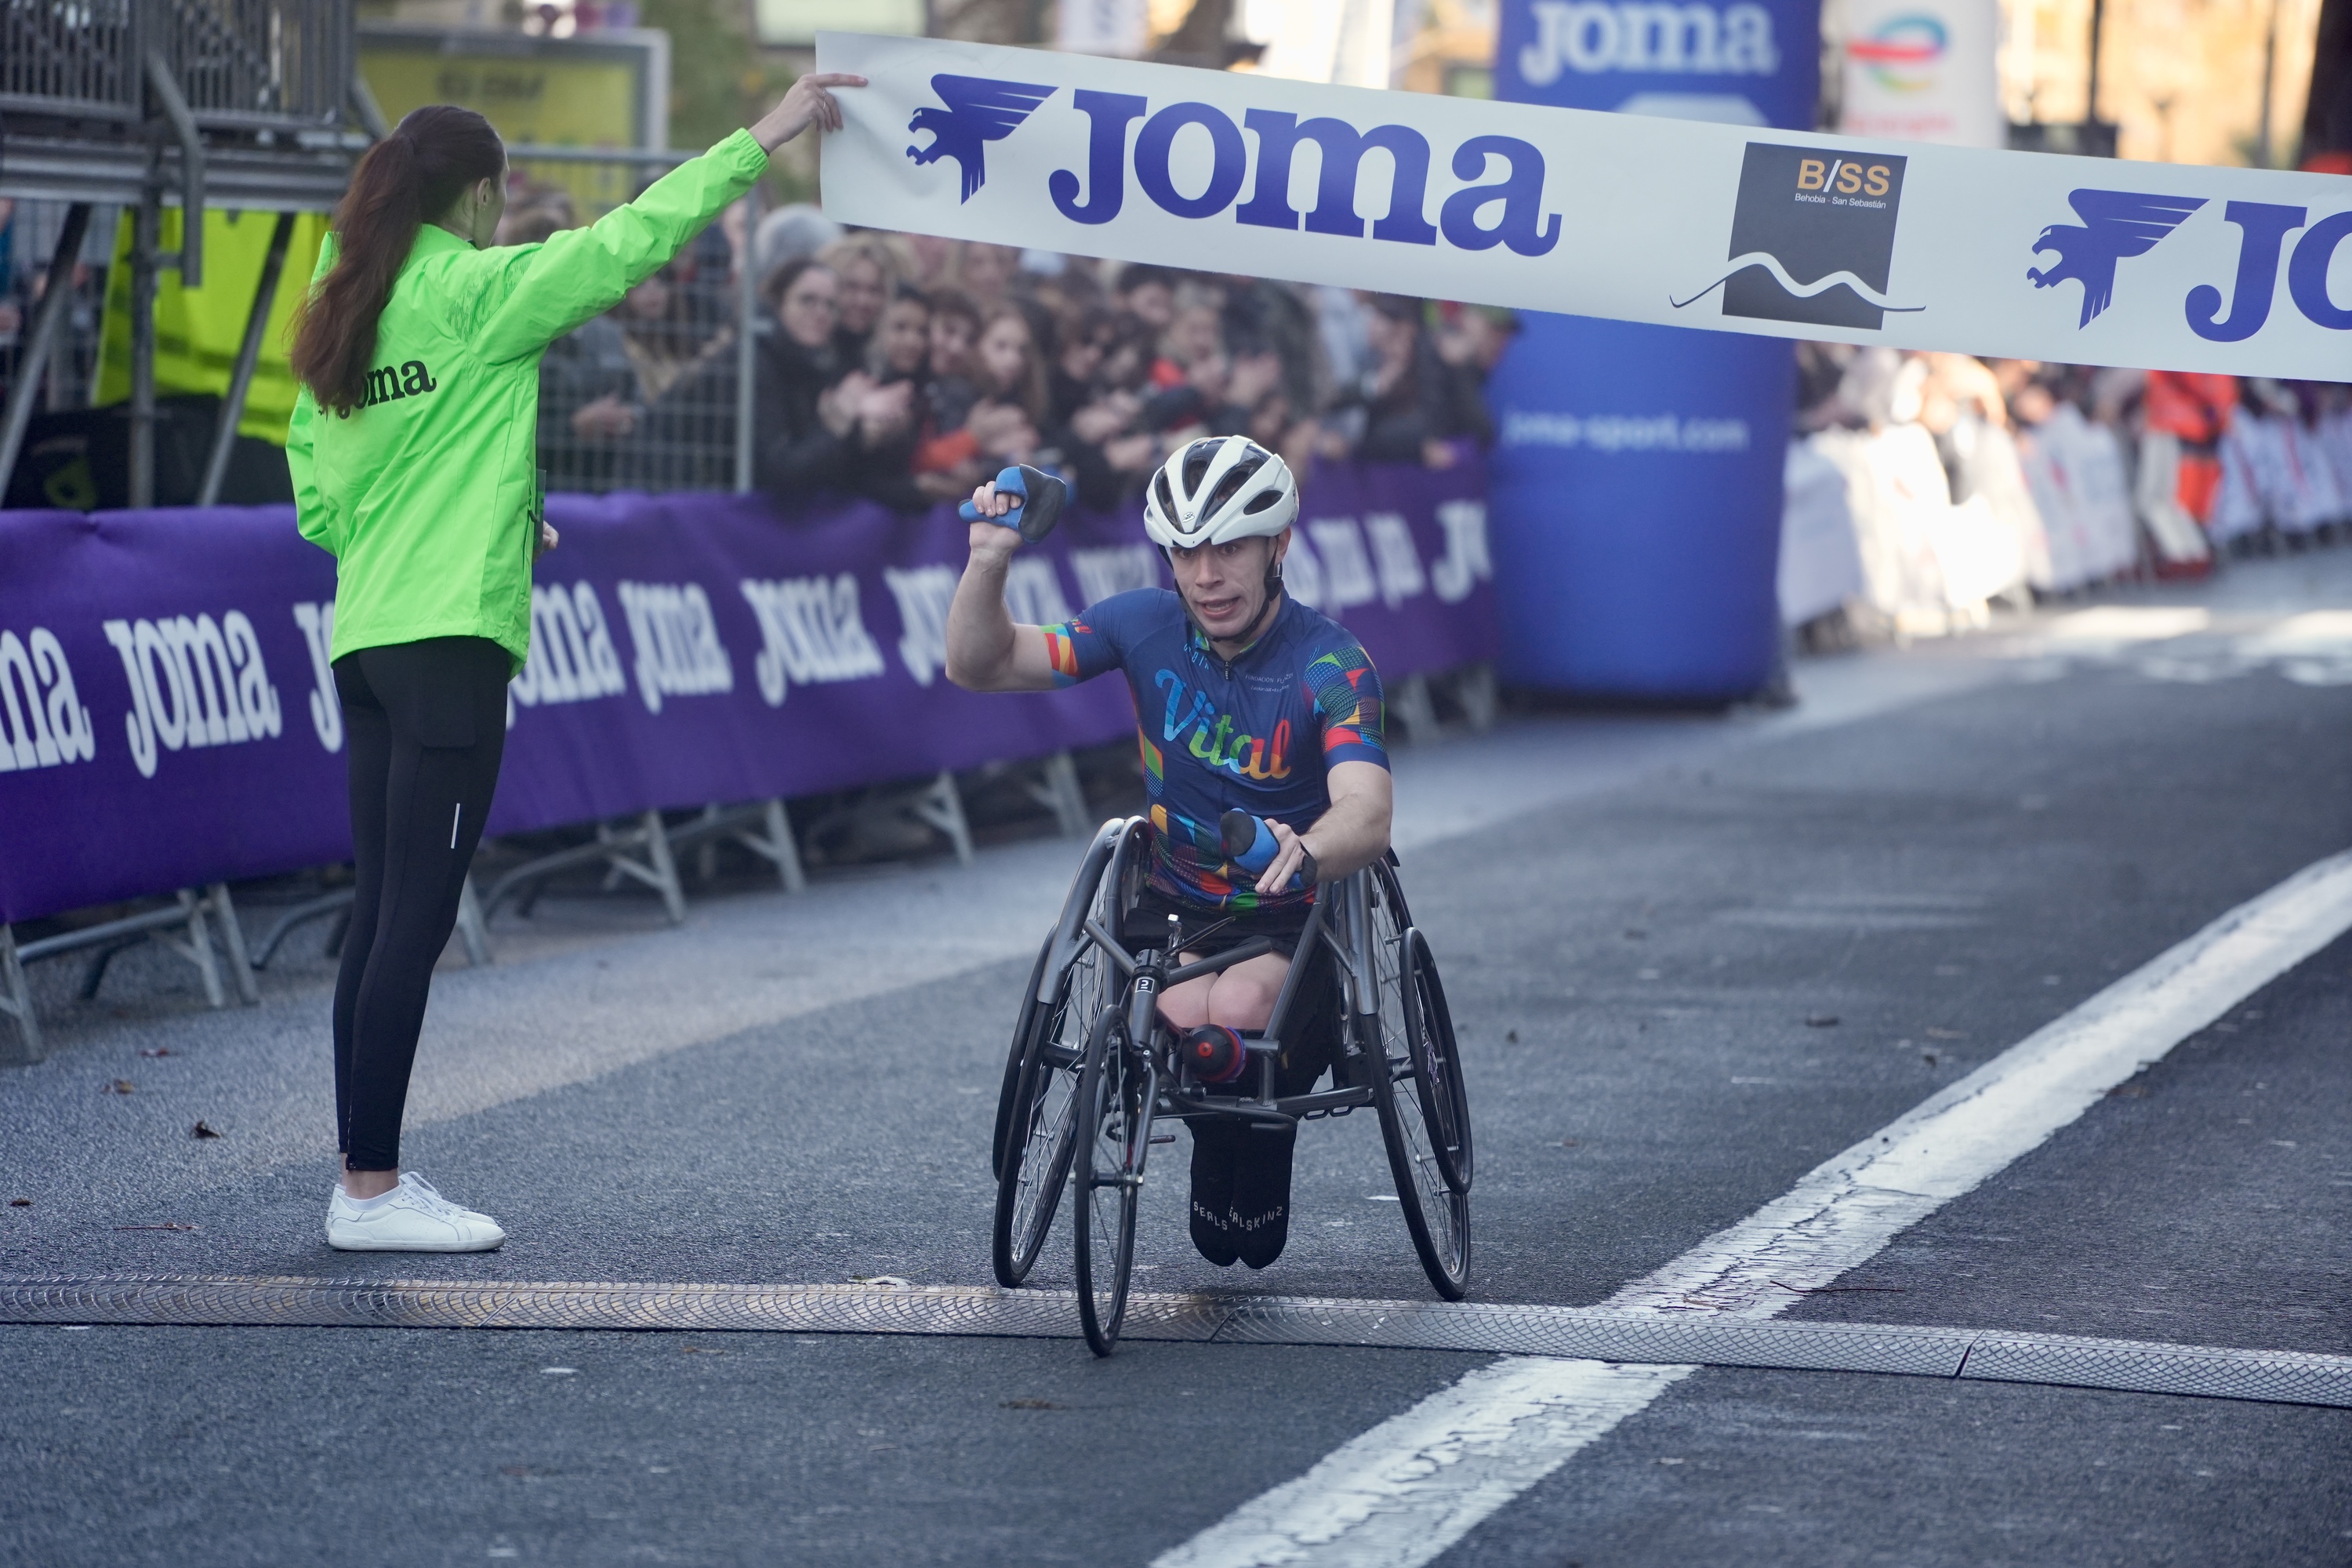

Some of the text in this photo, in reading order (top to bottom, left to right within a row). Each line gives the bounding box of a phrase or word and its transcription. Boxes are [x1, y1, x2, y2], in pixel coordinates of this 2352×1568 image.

[1049, 89, 1562, 256] Joma
[1795, 193, 1826, 204] Behobia
[1831, 196, 1847, 205] San
[1849, 198, 1886, 209] Sebastián
[1797, 159, 1890, 196] B/SS
[336, 360, 437, 419] oma
[1154, 669, 1291, 780] Vital
